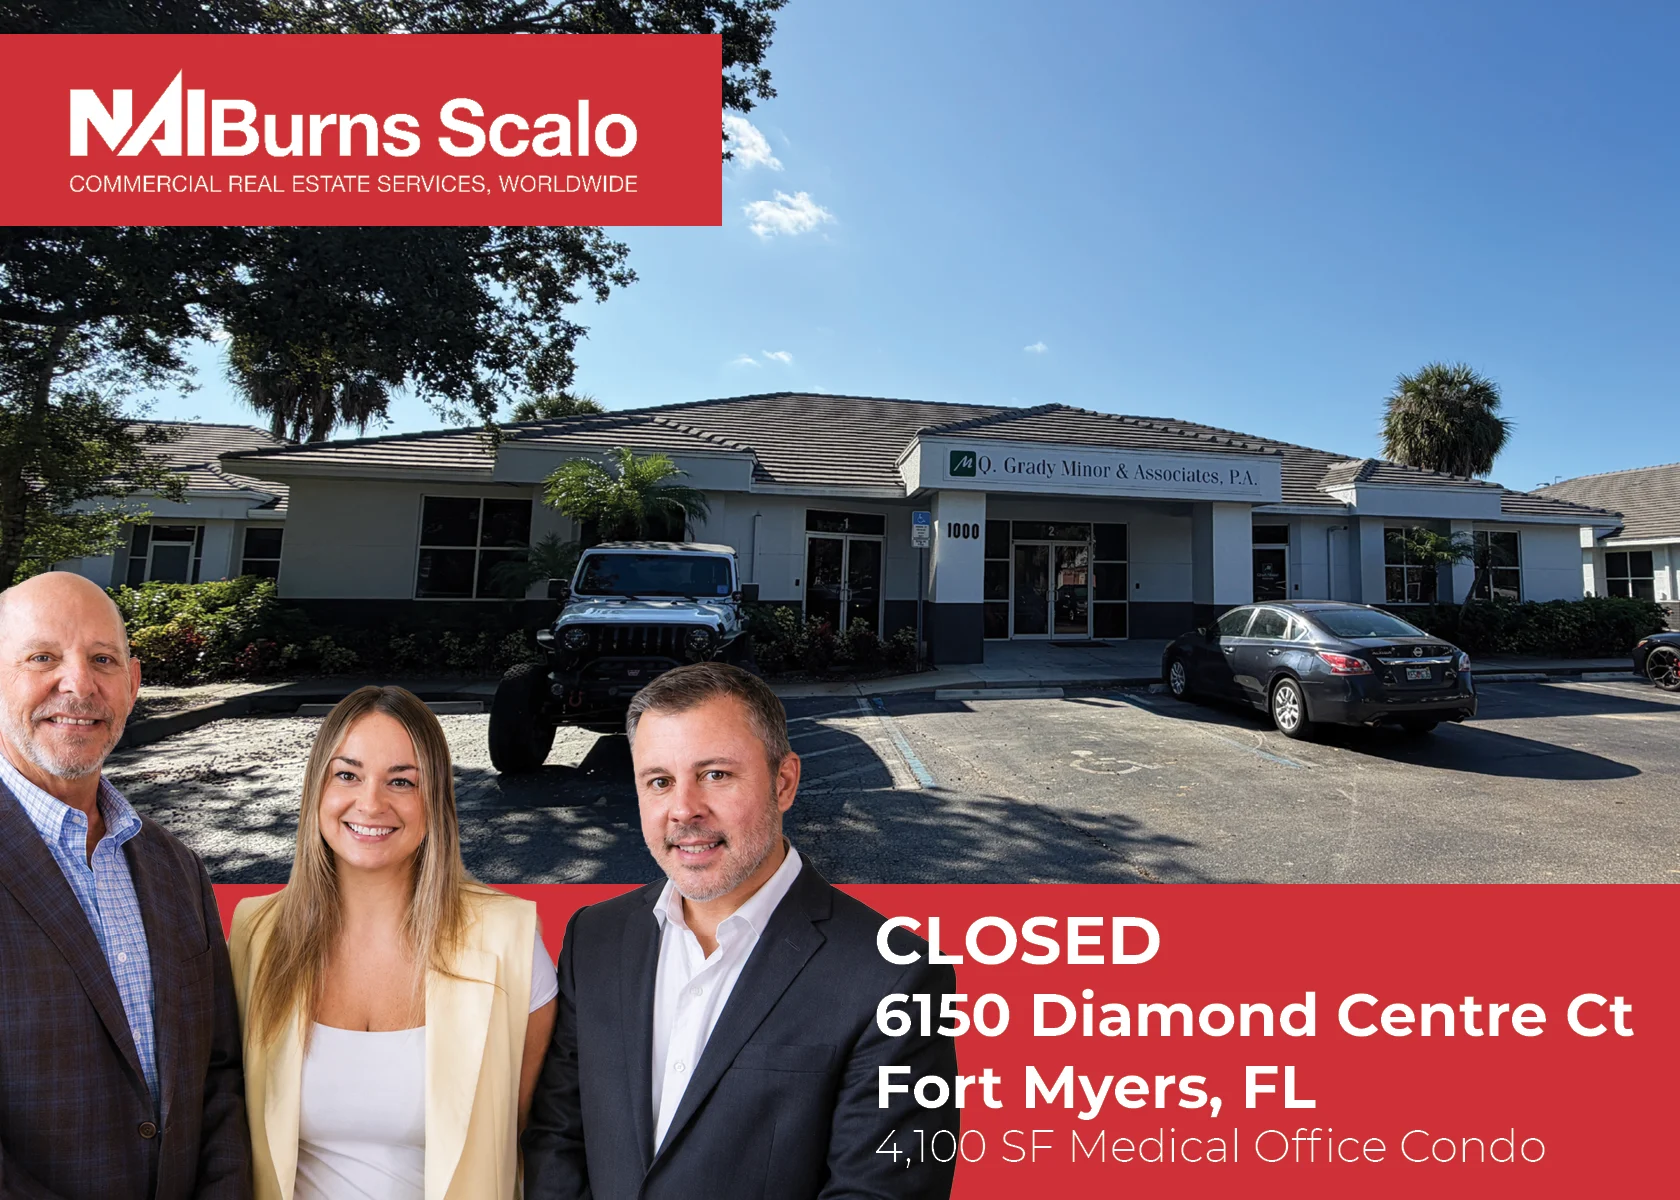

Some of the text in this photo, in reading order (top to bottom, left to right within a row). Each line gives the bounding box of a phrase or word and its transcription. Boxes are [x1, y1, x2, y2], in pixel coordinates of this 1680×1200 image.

[978, 455, 997, 475] Q.
[1004, 456, 1057, 479] Grady
[1060, 459, 1112, 479] Minor
[1115, 462, 1129, 480] &
[1133, 463, 1223, 486] Associates,
[1229, 469, 1258, 486] P.A.
[947, 522, 980, 540] 1000
[1048, 526, 1055, 536] 2
